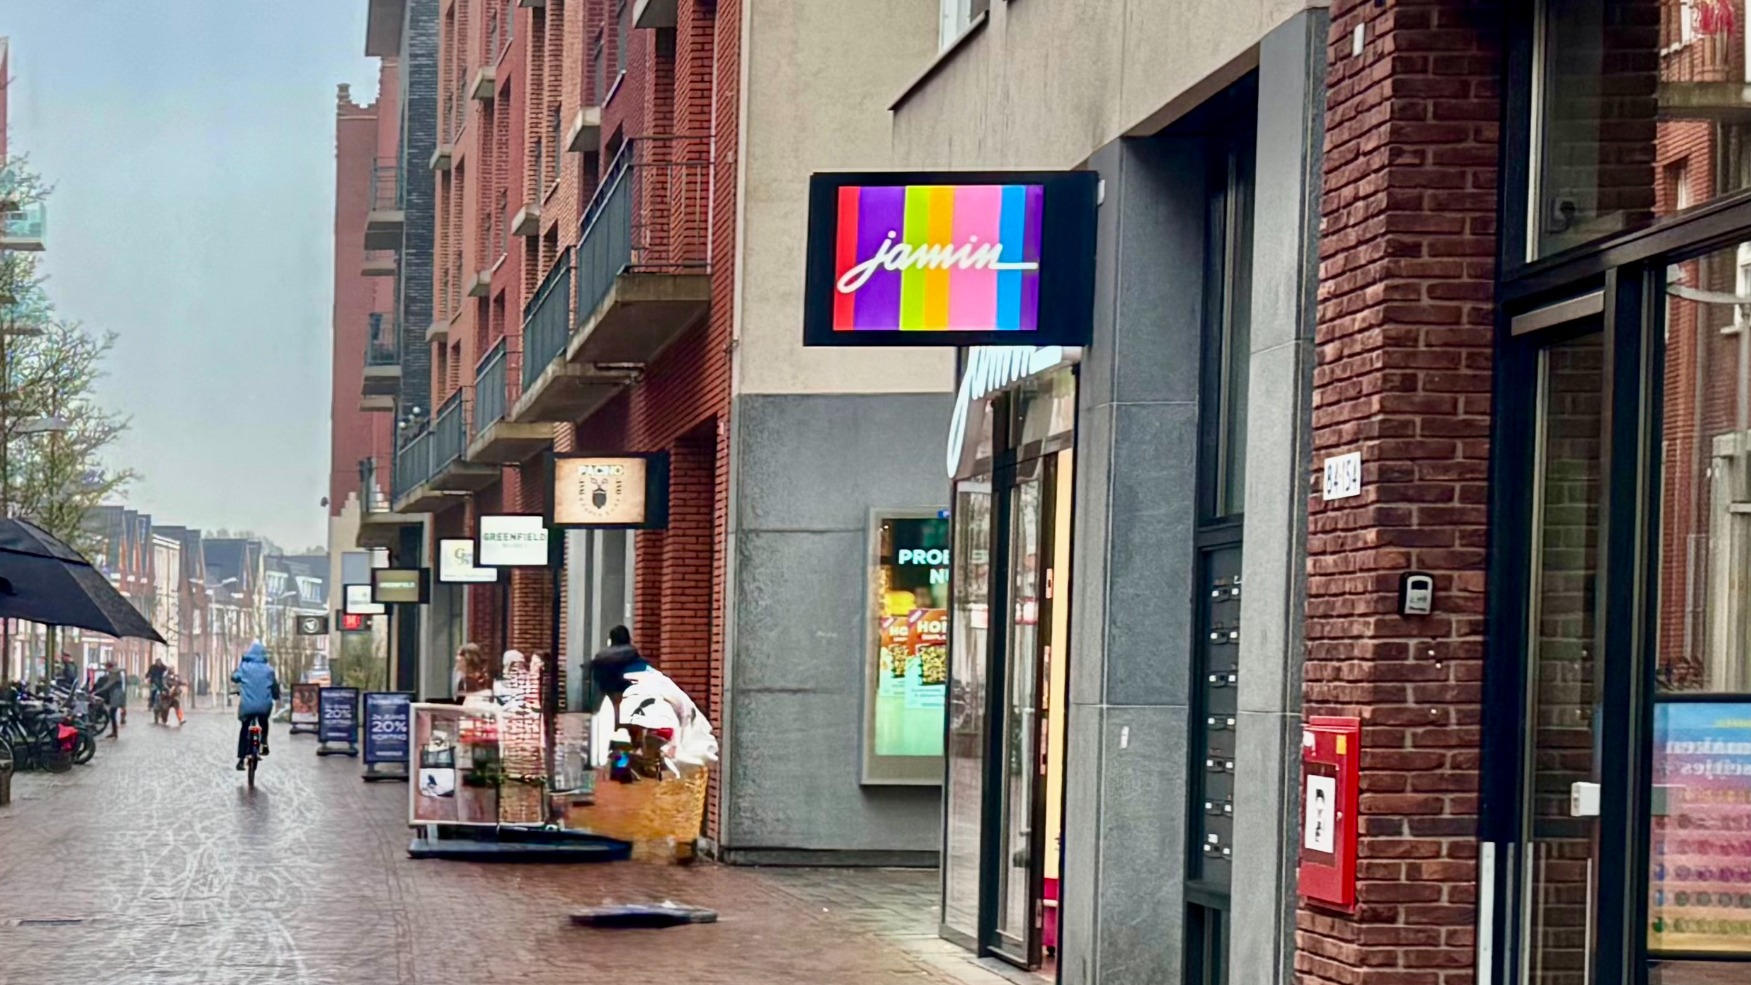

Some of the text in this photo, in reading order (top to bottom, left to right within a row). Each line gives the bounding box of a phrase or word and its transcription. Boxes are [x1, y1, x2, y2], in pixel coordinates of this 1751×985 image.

[837, 231, 1038, 293] jamin
[483, 532, 546, 542] GREENFIELD
[325, 709, 352, 719] 20%
[371, 721, 408, 732] 20%
